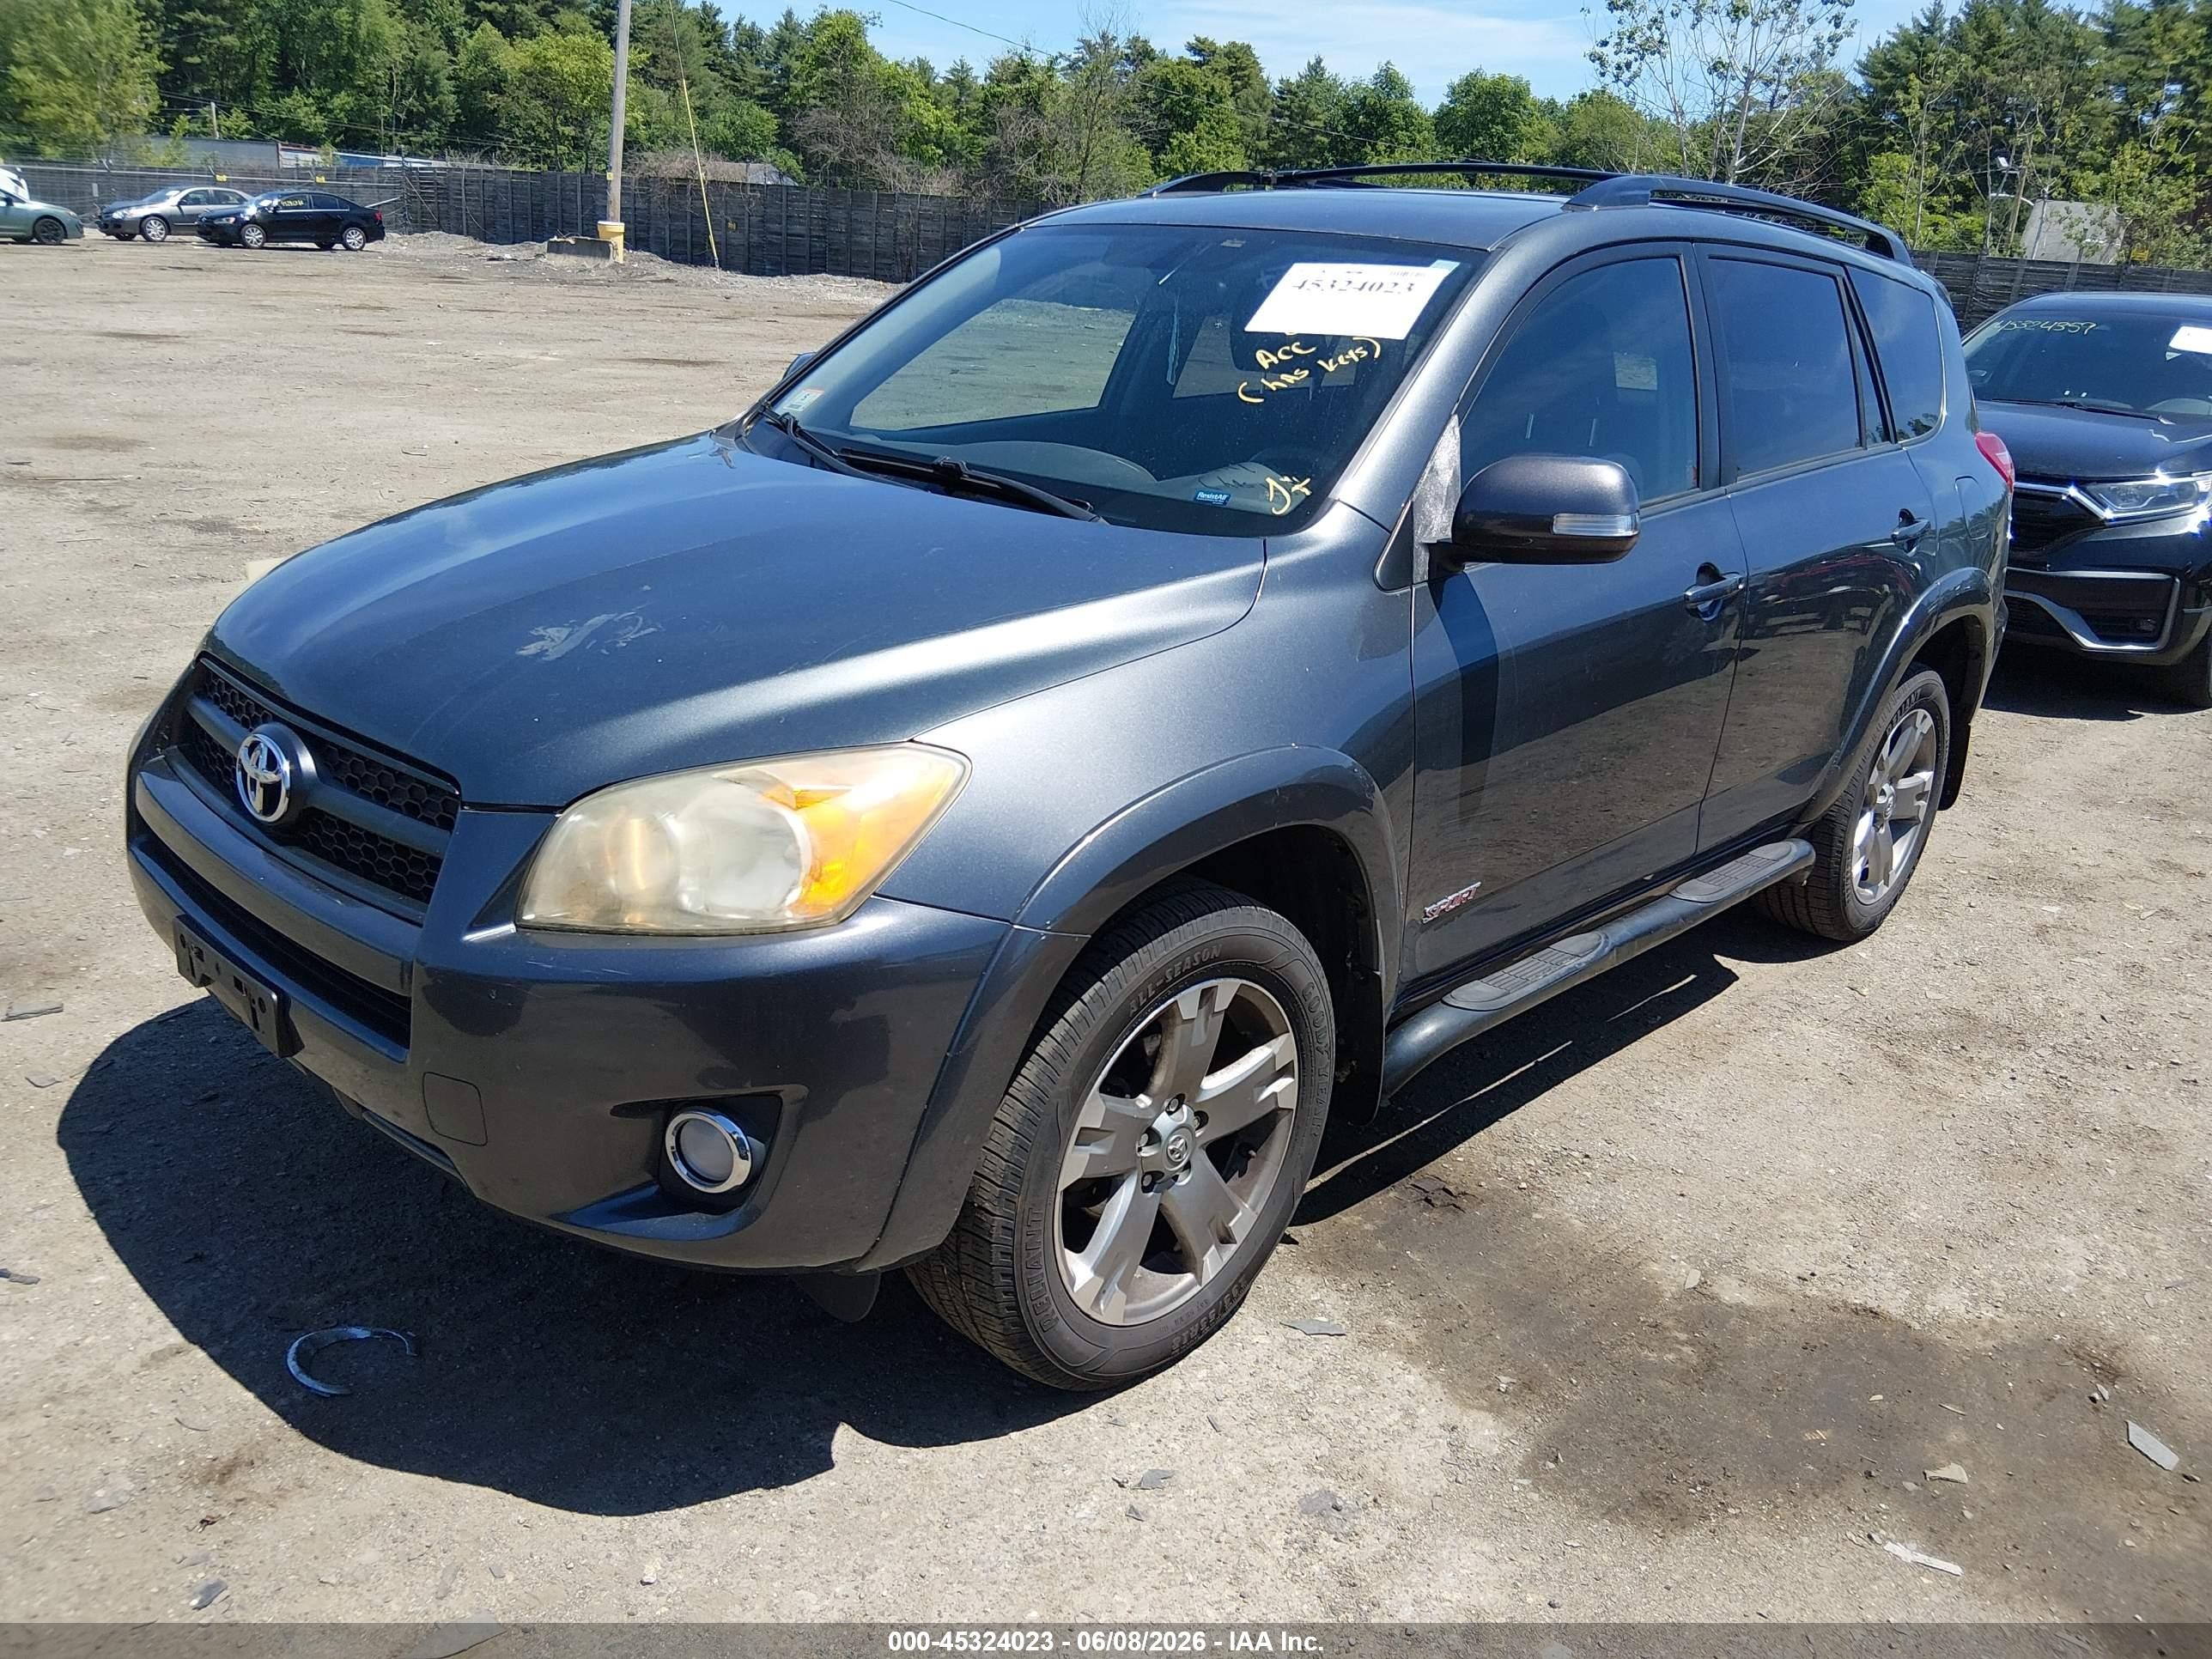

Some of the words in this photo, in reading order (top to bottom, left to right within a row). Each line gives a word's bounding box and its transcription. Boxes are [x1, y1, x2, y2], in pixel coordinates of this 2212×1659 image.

[1292, 278, 1415, 294] 45324023
[1129, 945, 1222, 1018] ALL-SEASON
[1025, 1206, 1059, 1334] RELIANT
